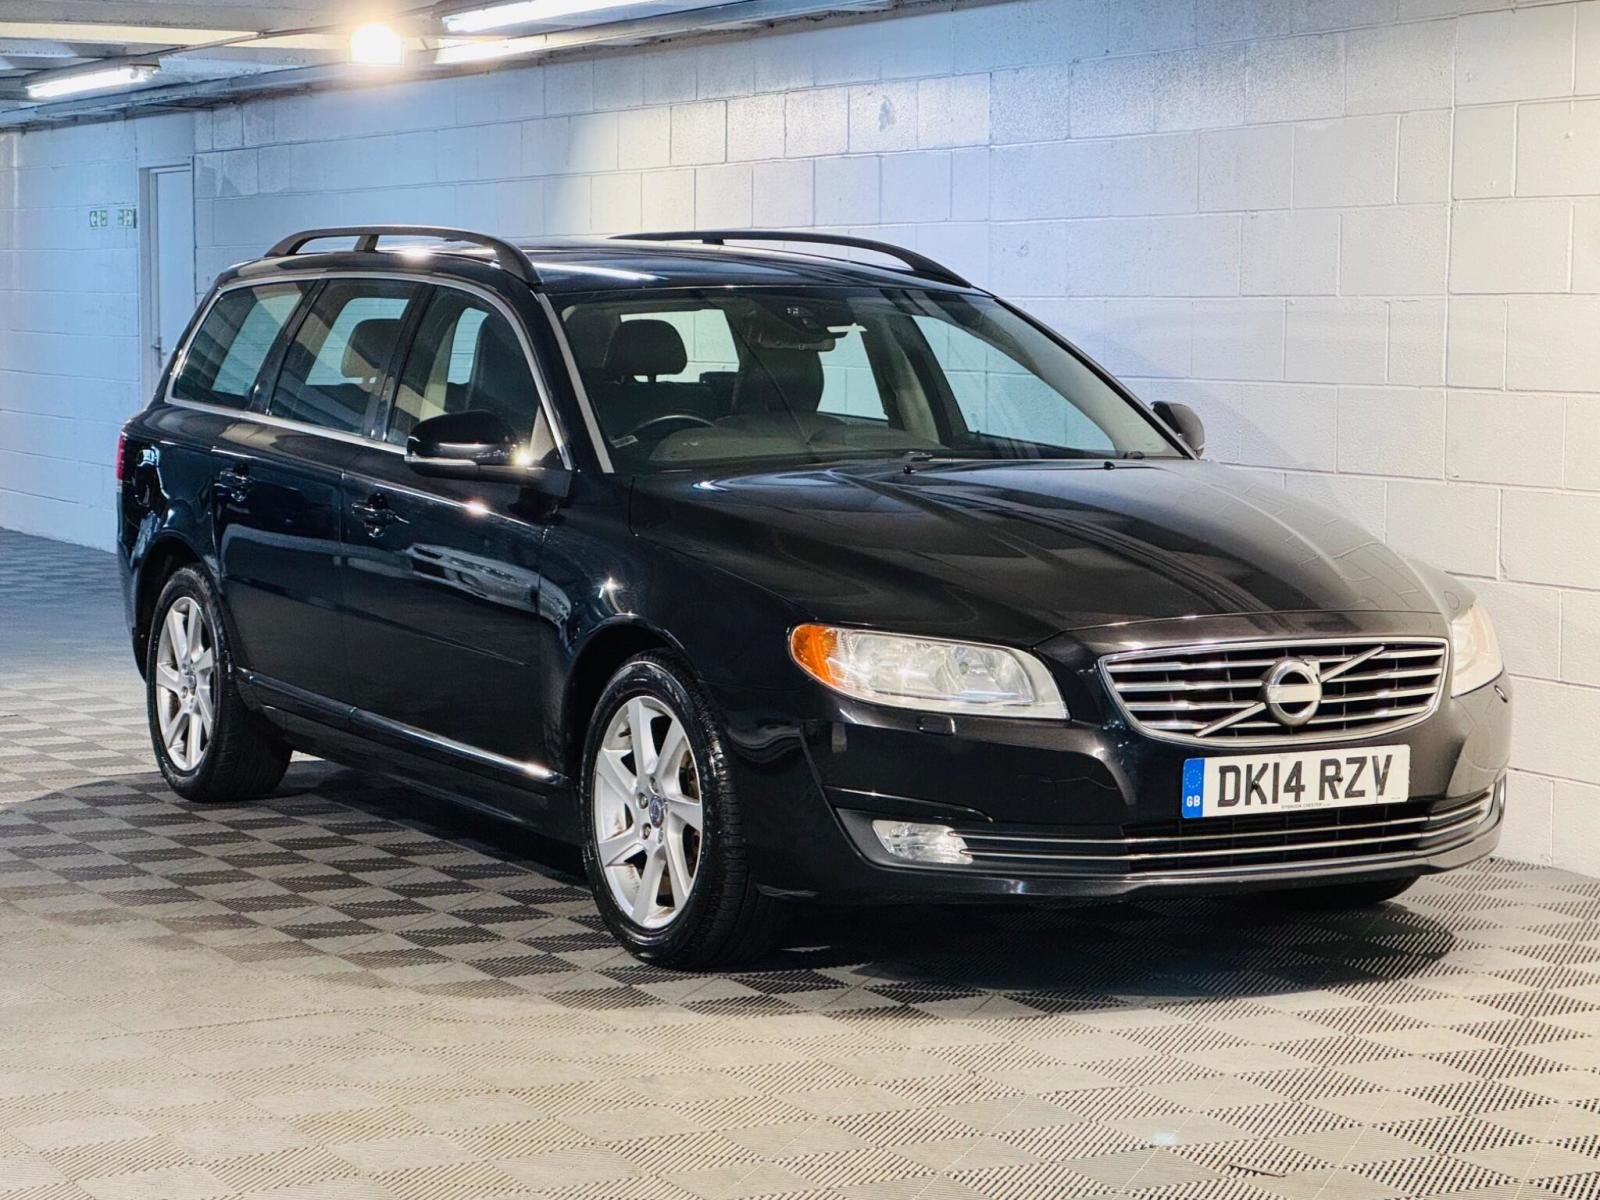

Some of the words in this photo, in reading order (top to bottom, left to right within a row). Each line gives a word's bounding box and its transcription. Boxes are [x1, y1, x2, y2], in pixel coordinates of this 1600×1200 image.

[1217, 760, 1306, 808] DK14
[1318, 754, 1393, 801] RZV
[1186, 795, 1201, 807] GB
